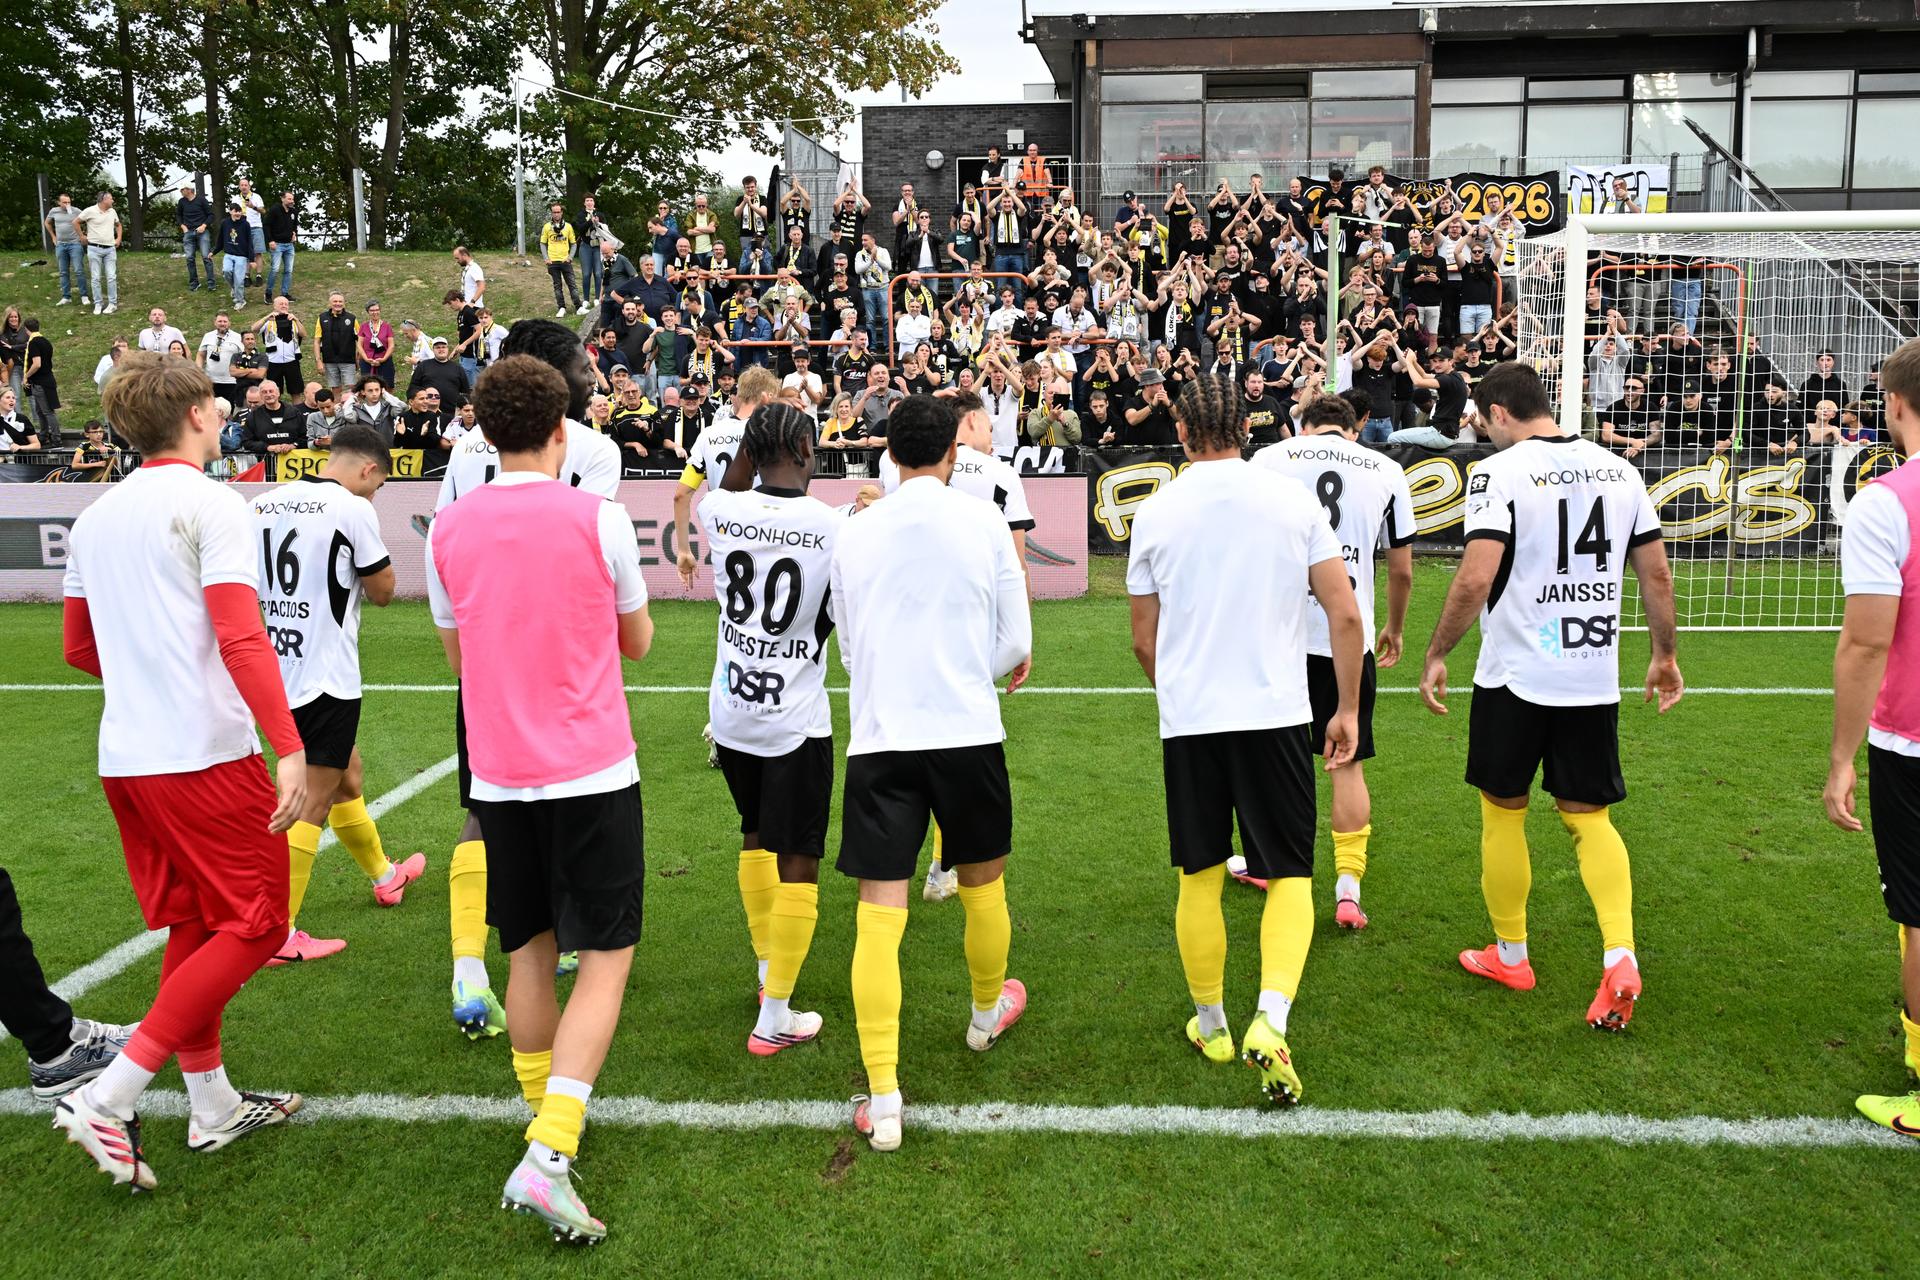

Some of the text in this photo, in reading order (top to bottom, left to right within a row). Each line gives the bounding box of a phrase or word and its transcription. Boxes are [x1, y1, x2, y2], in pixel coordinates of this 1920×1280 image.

[1460, 183, 1551, 222] 2026
[708, 435, 743, 446] WOON
[1287, 449, 1380, 472] WOONHOEK
[1530, 469, 1627, 488] WOONHOEK
[1316, 471, 1343, 532] 8
[715, 518, 826, 550] WOONHOEK
[1557, 496, 1614, 575] 14
[263, 527, 300, 597] 16
[725, 550, 804, 636] 80
[1536, 583, 1617, 603] JANSSE
[782, 639, 809, 659] JR
[728, 660, 785, 706] DSR
